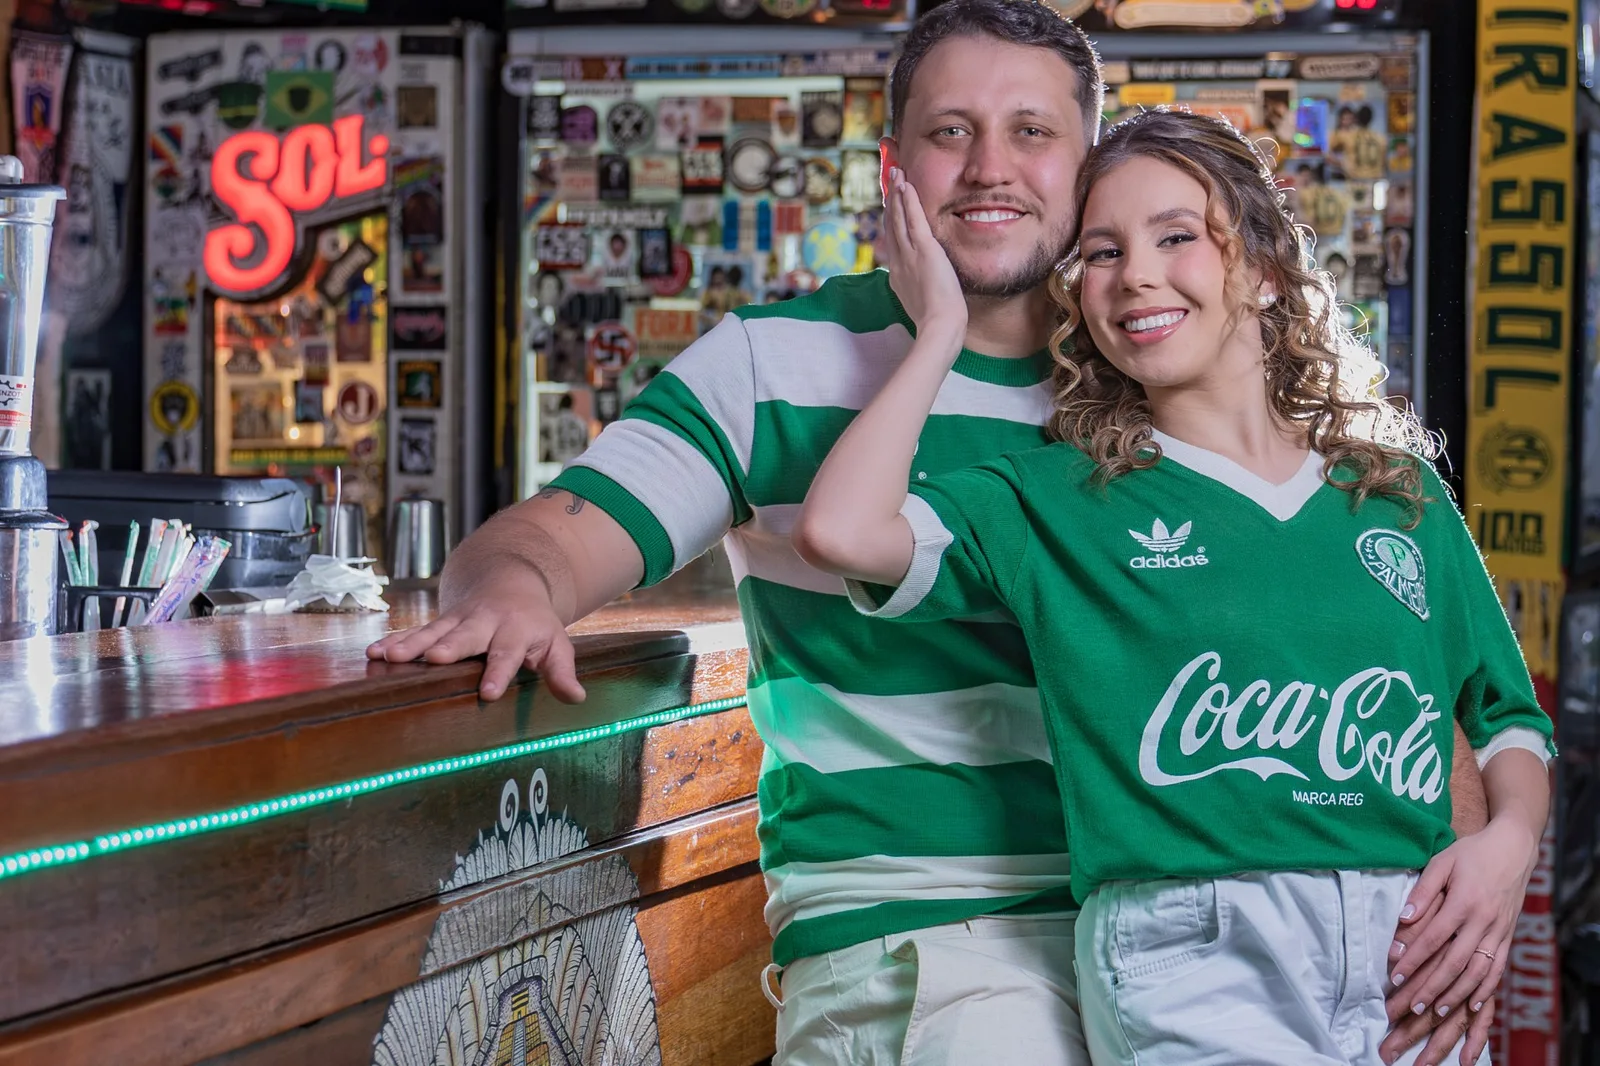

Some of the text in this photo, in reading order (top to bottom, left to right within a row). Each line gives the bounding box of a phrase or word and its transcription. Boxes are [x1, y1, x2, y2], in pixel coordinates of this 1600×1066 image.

[204, 114, 390, 292] SOL
[1130, 554, 1209, 568] adidas
[1138, 651, 1445, 804] Coca-Cola
[1292, 790, 1364, 806] MARCA REG
